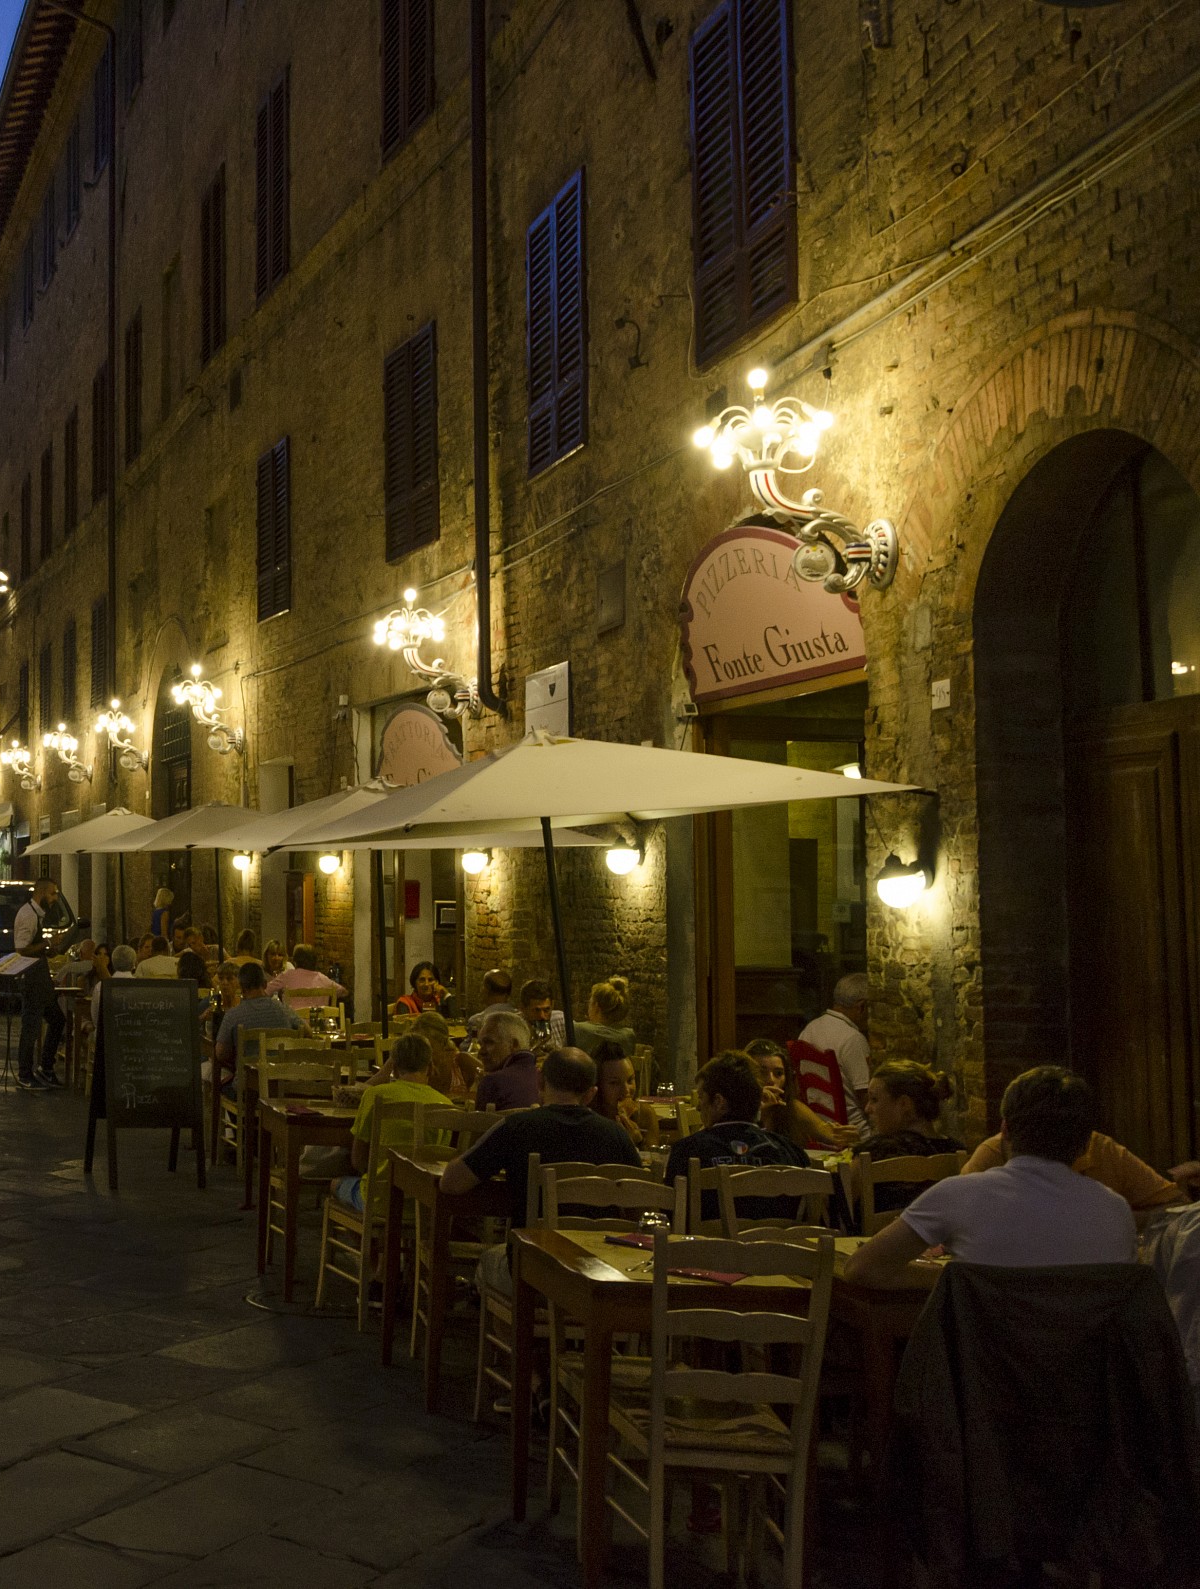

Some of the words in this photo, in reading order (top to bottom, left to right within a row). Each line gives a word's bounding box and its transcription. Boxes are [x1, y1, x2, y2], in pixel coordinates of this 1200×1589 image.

[696, 547, 801, 620] PIZZERIA
[702, 643, 765, 683] Fonte
[763, 621, 849, 667] Giusta
[384, 720, 448, 768] TRATTORIA
